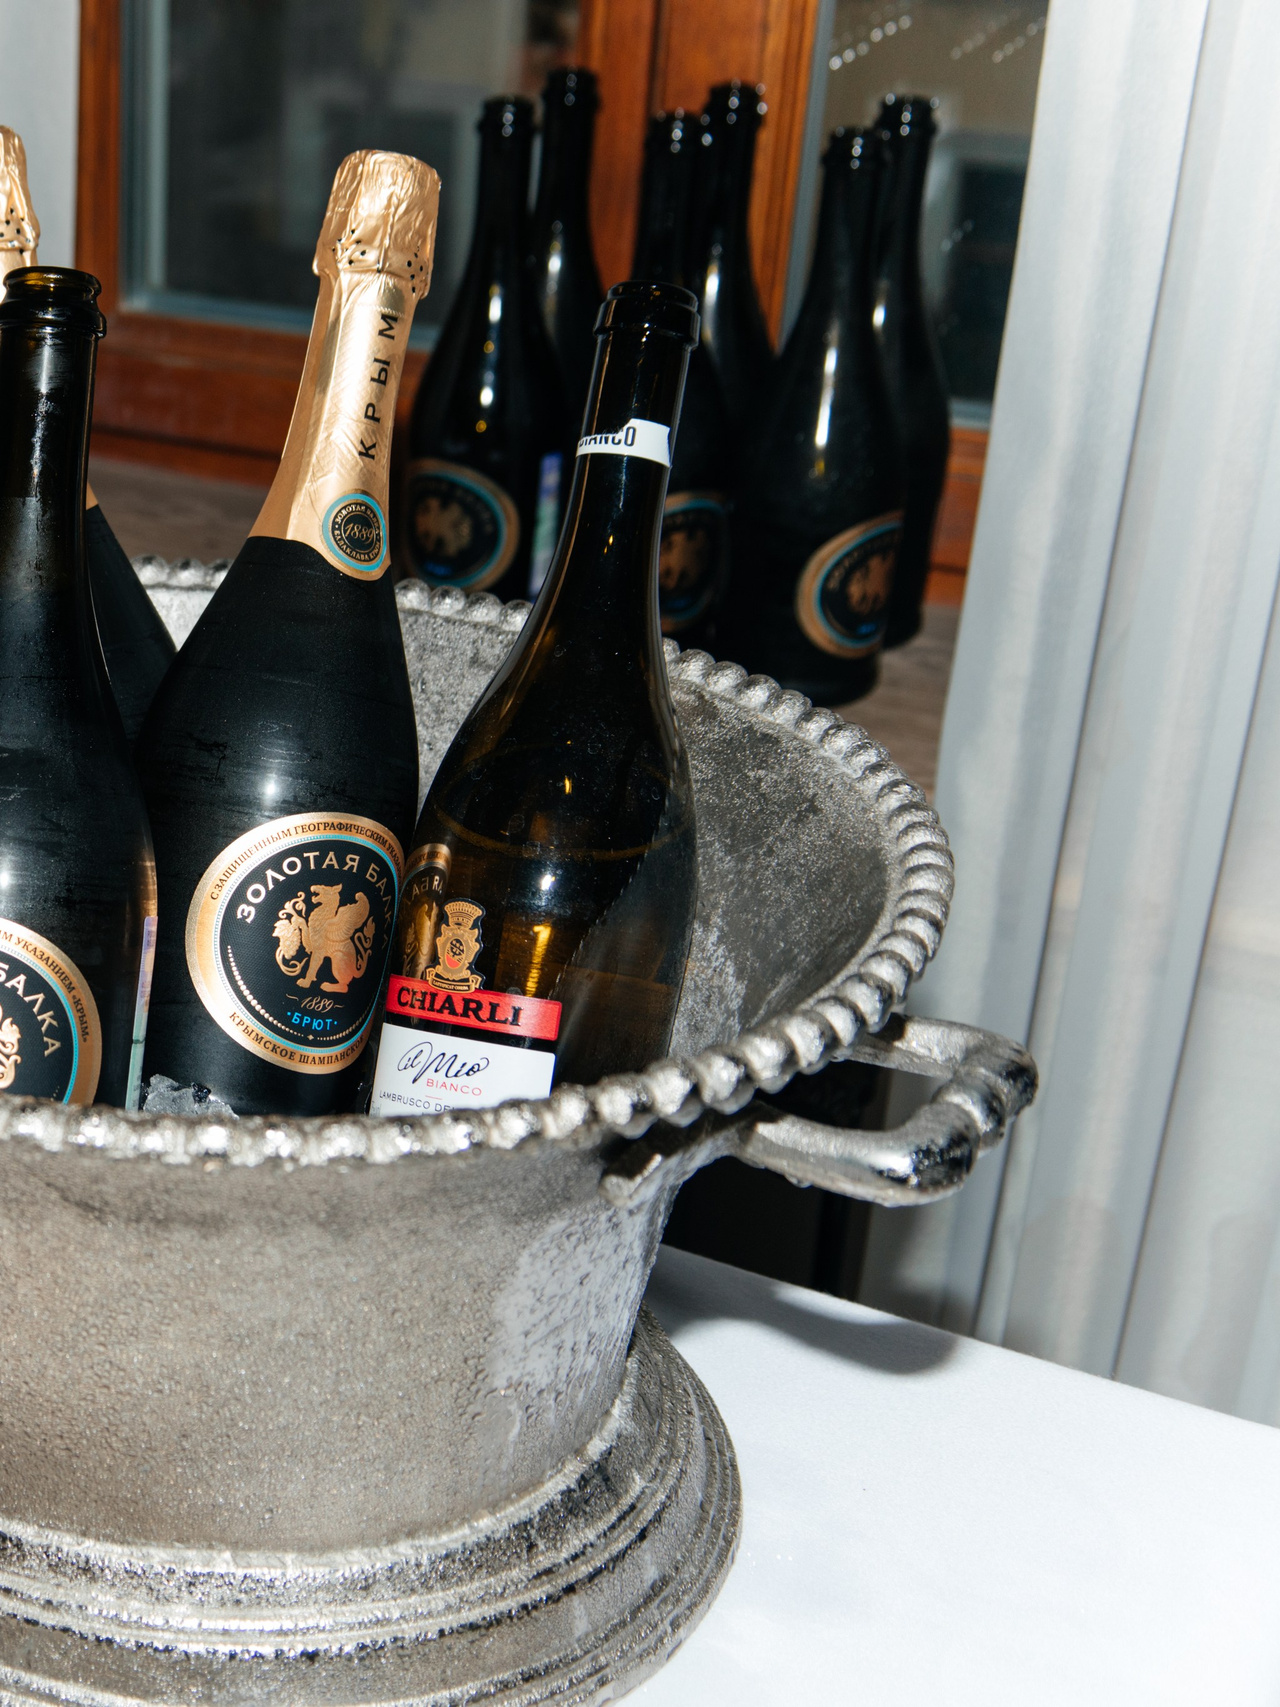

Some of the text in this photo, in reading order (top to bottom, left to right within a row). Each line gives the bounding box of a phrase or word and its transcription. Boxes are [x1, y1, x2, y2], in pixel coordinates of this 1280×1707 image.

[358, 313, 399, 461] КРЫМ
[213, 829, 293, 897] ЗАЩИЩЕННЫМ
[293, 821, 390, 850] ГЕОГРАФИЧЕСКИМ
[236, 851, 361, 924] ЗОЛОТАЯ
[14, 935, 76, 994] УКАЗАНИЕМ
[291, 1012, 333, 1031] БРЮТ
[300, 994, 335, 1014] 1889
[396, 986, 524, 1027] CHIARLI
[228, 1010, 365, 1066] КРЫМСКОЕ ШАМПАНСКОЕ
[378, 1090, 432, 1111] LAMBRUSCO
[433, 1102, 455, 1113] DE
[425, 1077, 483, 1097] BIANCO
